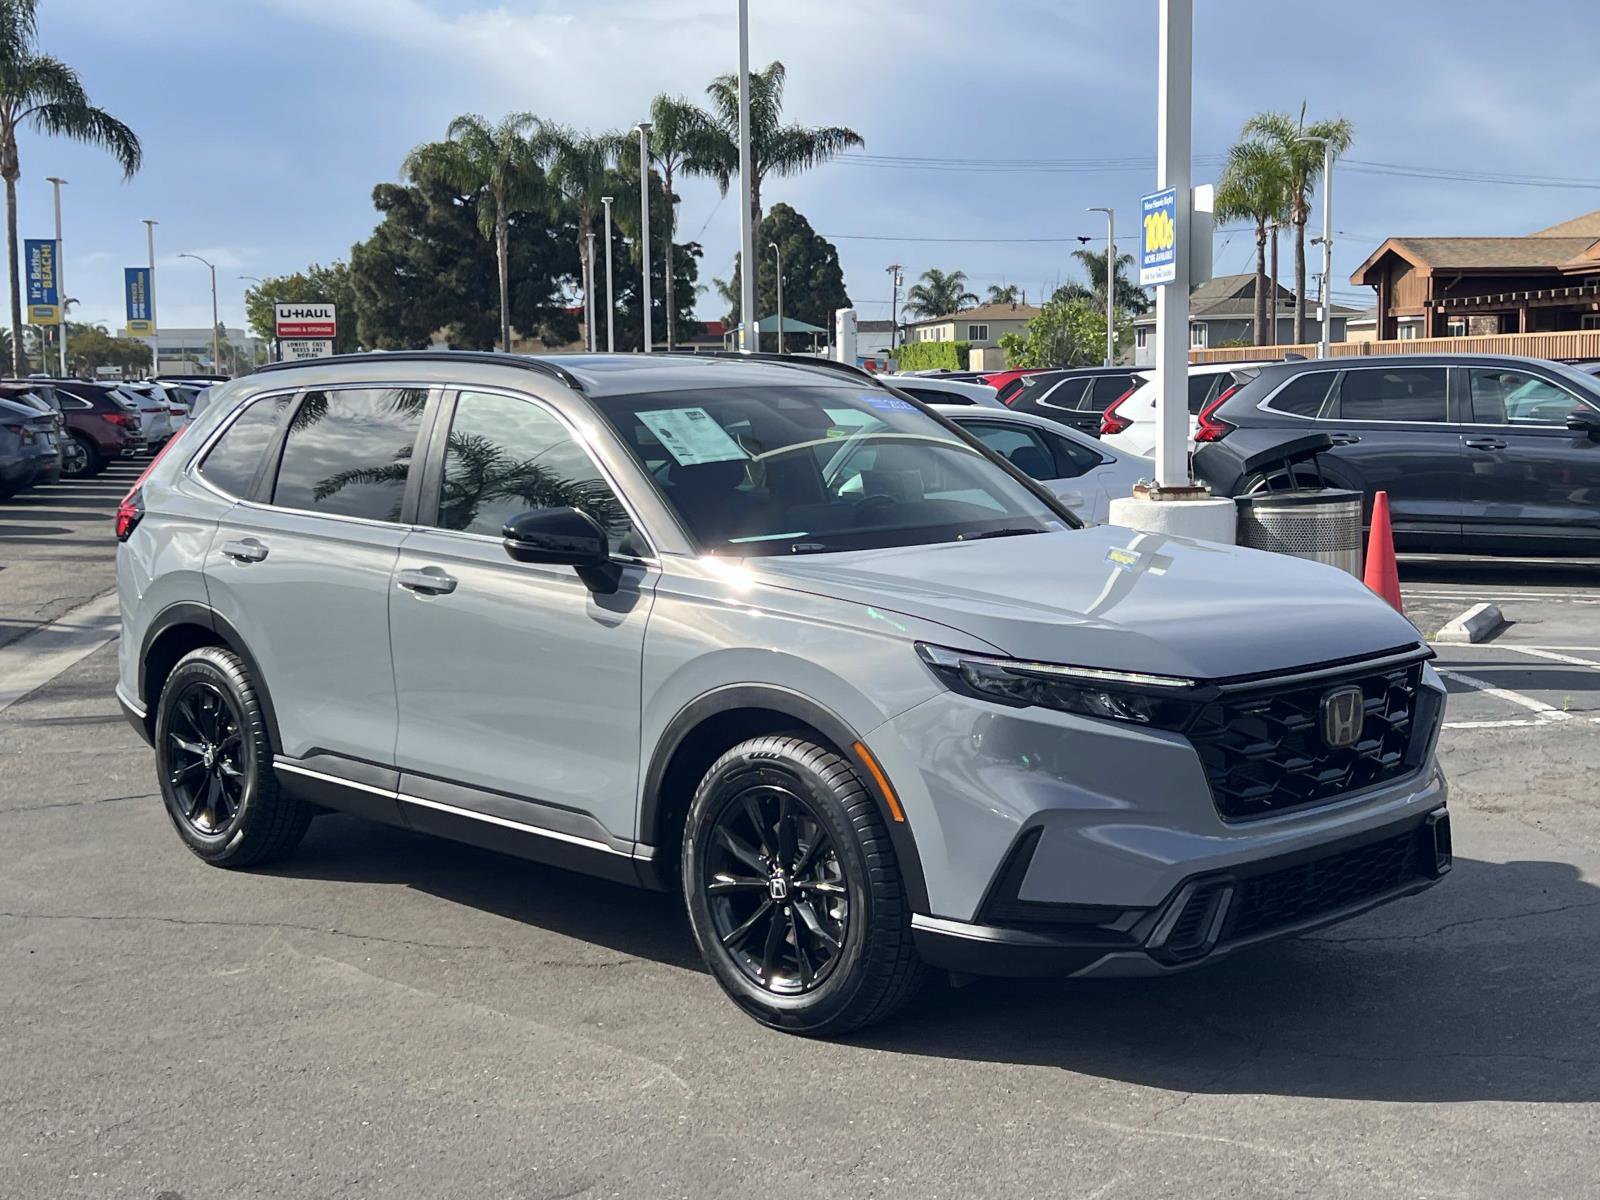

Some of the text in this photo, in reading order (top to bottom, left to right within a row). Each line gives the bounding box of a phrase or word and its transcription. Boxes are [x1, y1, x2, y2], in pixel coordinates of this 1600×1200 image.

[31, 247, 41, 299] It's Better
[41, 244, 53, 289] BEACH!
[280, 309, 332, 318] U-HAUL
